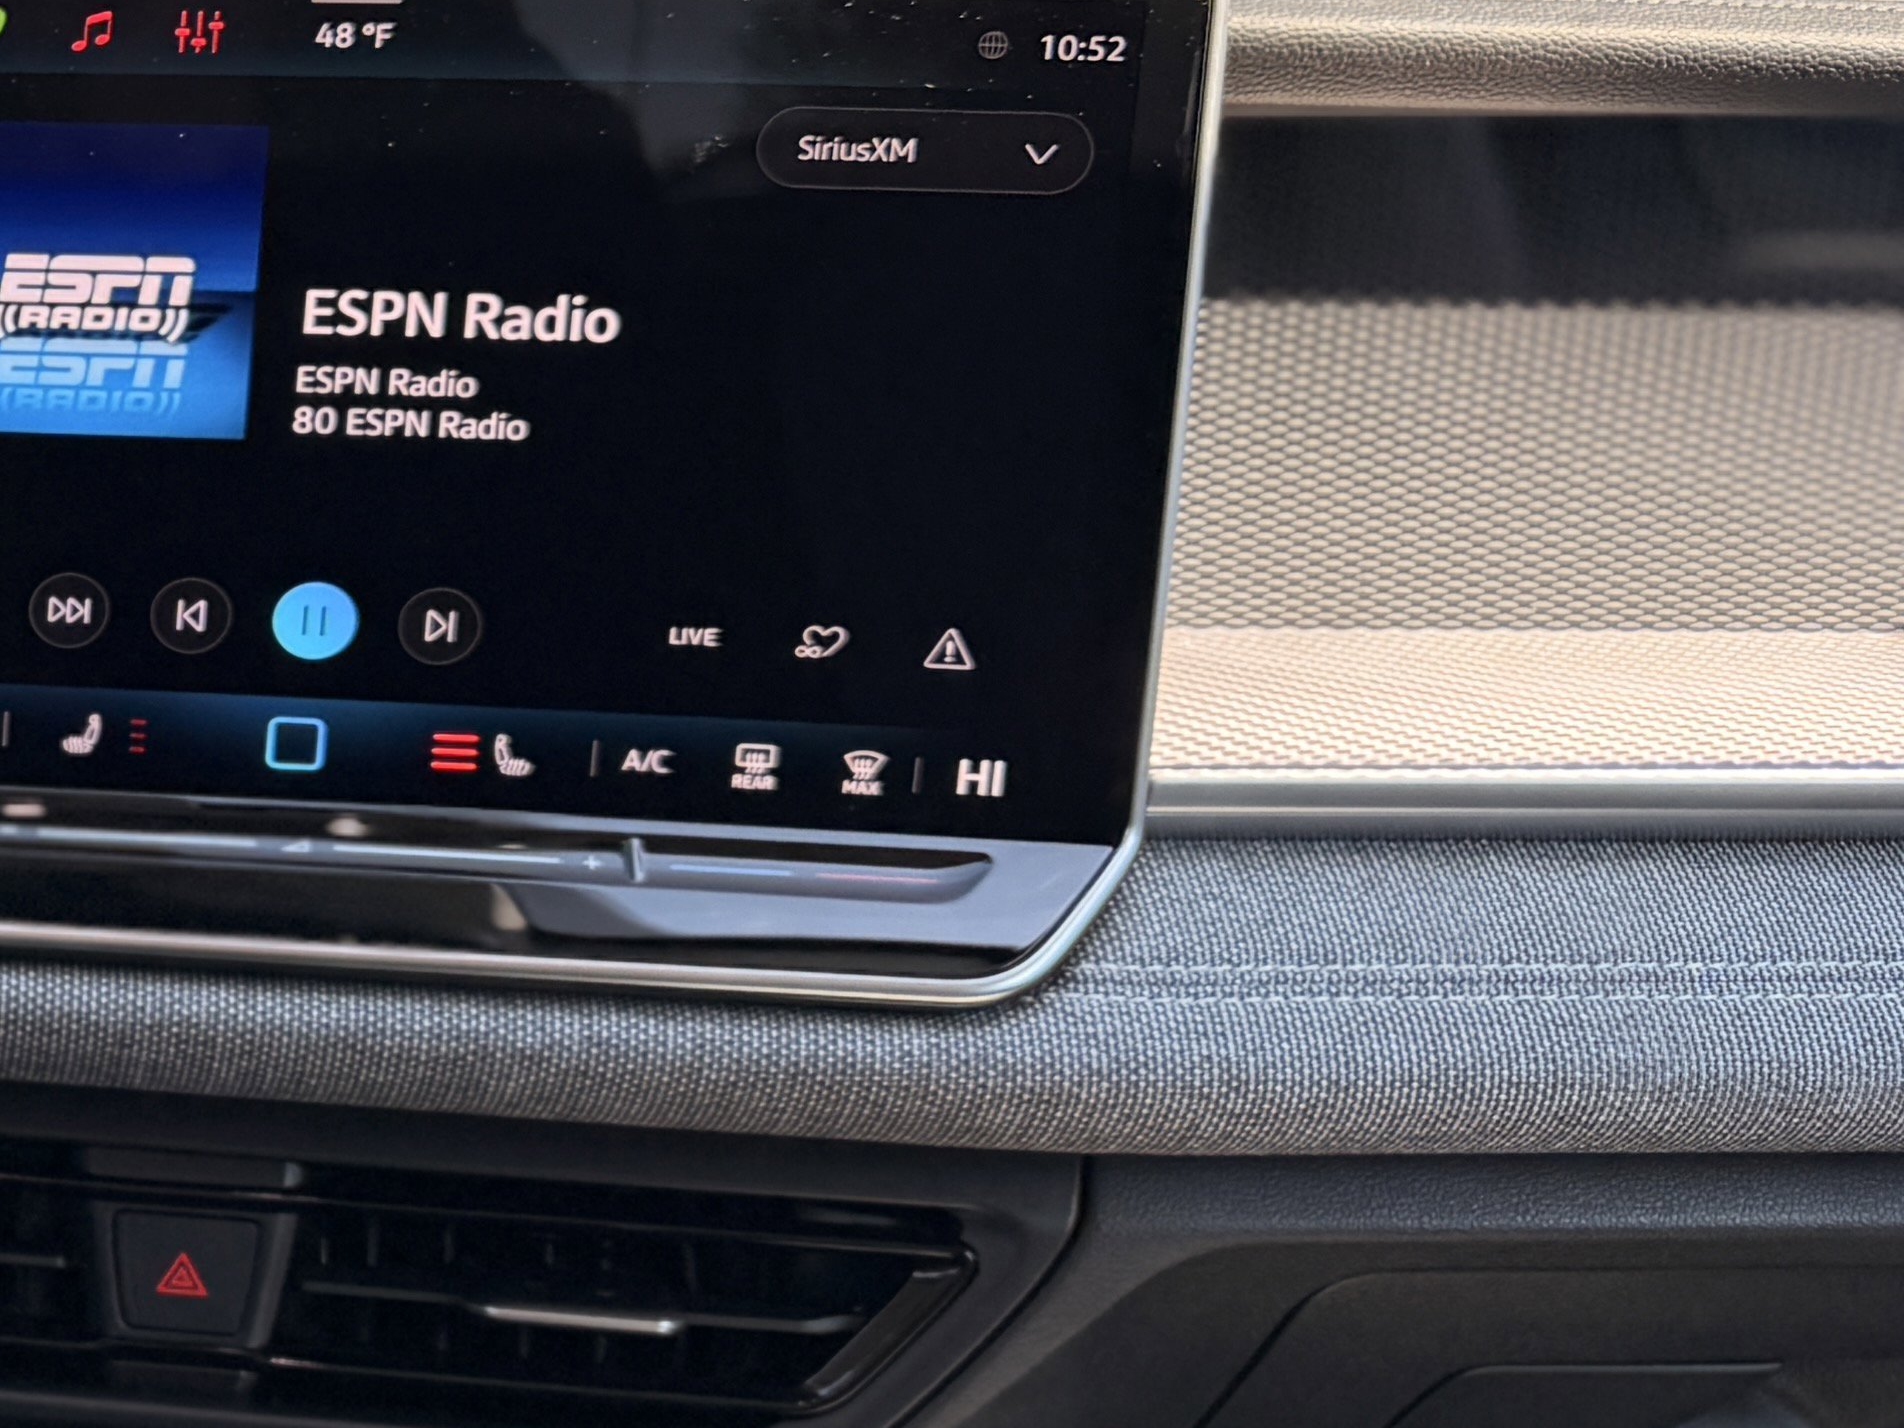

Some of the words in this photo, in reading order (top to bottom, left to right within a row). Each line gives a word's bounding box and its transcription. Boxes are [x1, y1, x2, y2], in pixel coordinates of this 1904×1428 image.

[314, 22, 356, 49] 48
[1040, 33, 1127, 62] 10:52
[797, 134, 919, 164] SiriusXM
[303, 288, 450, 339] ESPN
[463, 292, 622, 344] Radio
[295, 365, 382, 396] ESPN
[388, 368, 481, 399] Radio
[291, 405, 340, 435] 80
[345, 407, 433, 438] ESPN
[438, 410, 532, 442] Radio
[668, 626, 724, 648] LIVE
[621, 748, 677, 774] A/C
[730, 774, 779, 791] REAR
[841, 779, 884, 797] MAX
[956, 758, 1008, 798] HI
